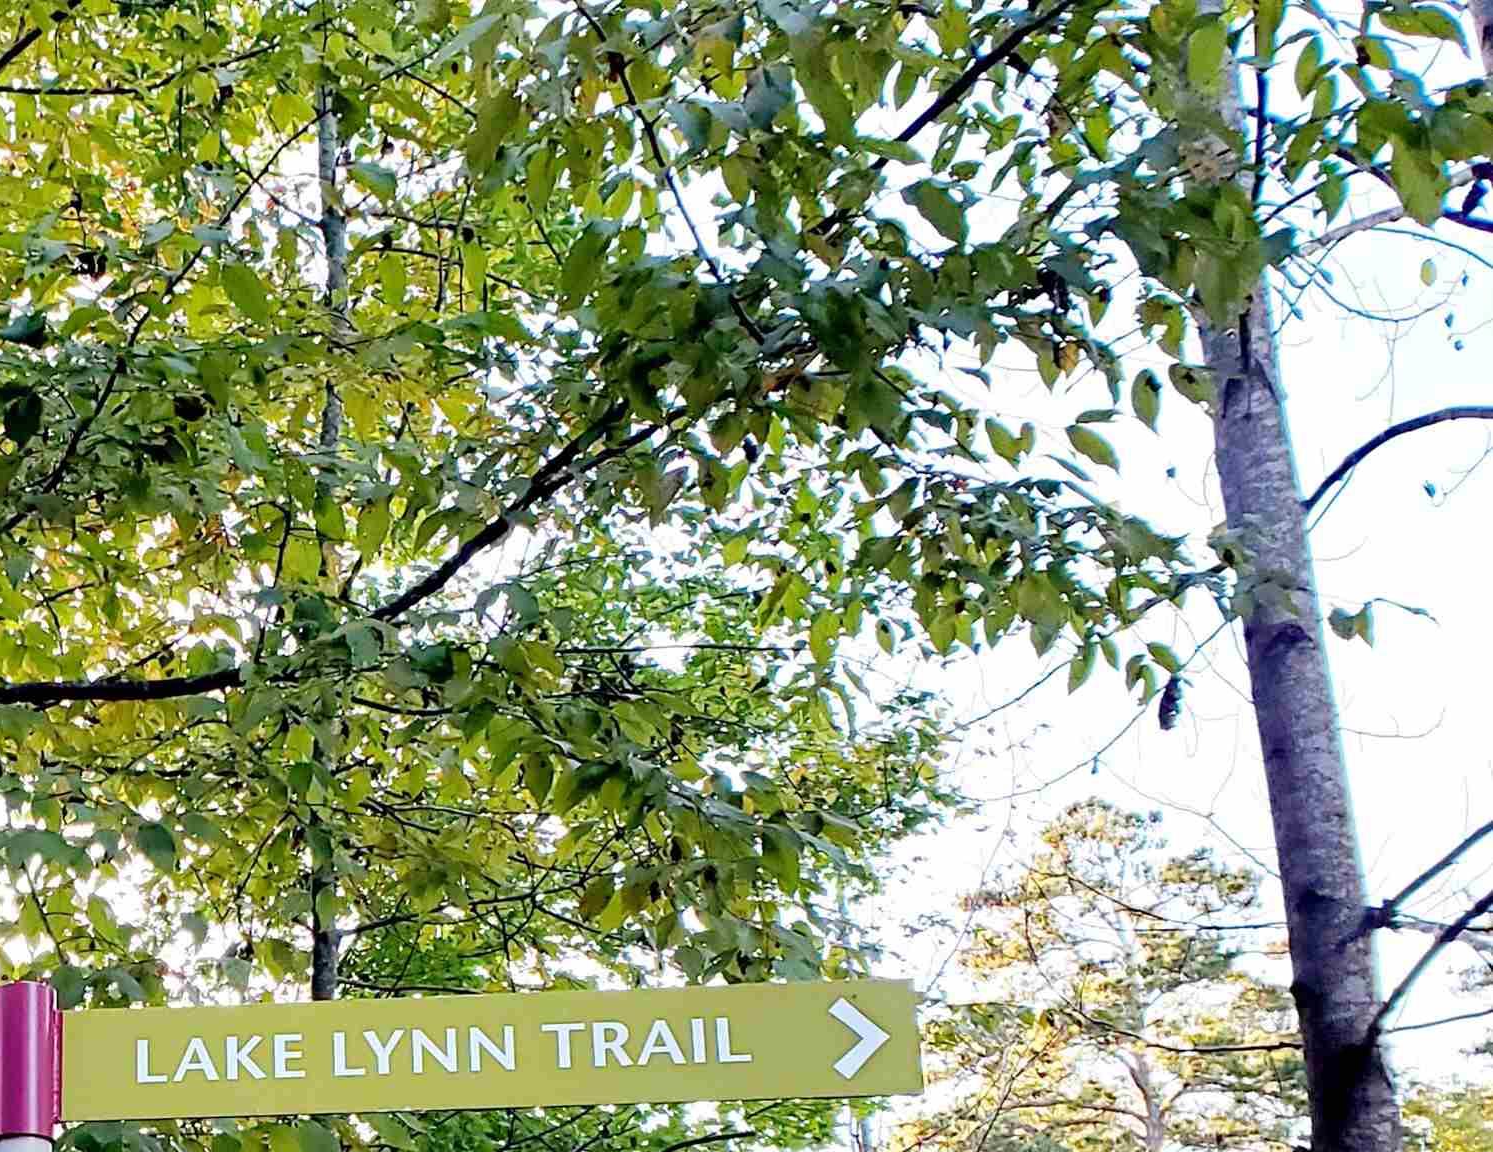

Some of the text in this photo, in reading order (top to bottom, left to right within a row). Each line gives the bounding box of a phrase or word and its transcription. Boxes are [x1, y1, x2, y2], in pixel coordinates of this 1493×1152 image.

[135, 1017, 753, 1083] LAKE LYNN TRAIL
